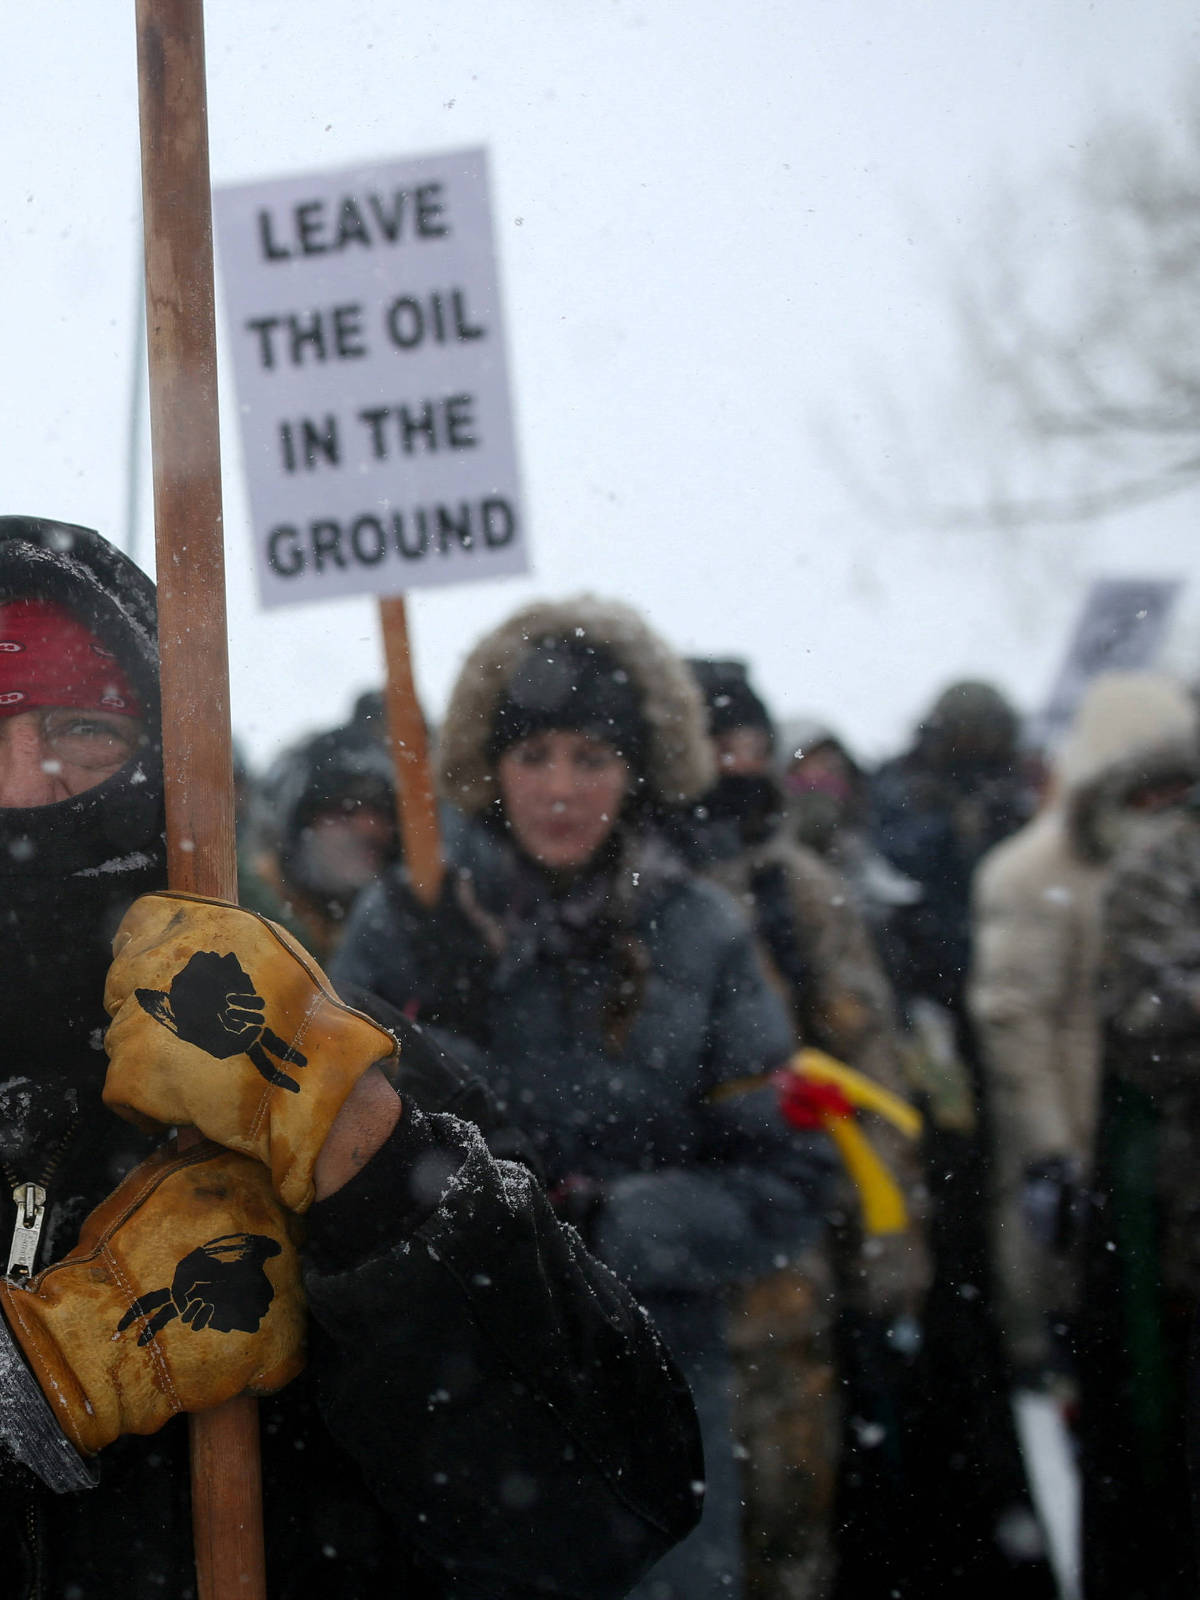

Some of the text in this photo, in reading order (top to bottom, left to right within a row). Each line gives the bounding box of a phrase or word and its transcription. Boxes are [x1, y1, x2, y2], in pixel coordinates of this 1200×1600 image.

[258, 181, 450, 262] LEAVE
[245, 289, 486, 370] THE OIL
[279, 394, 480, 474] IN THE
[266, 497, 516, 578] GROUND
